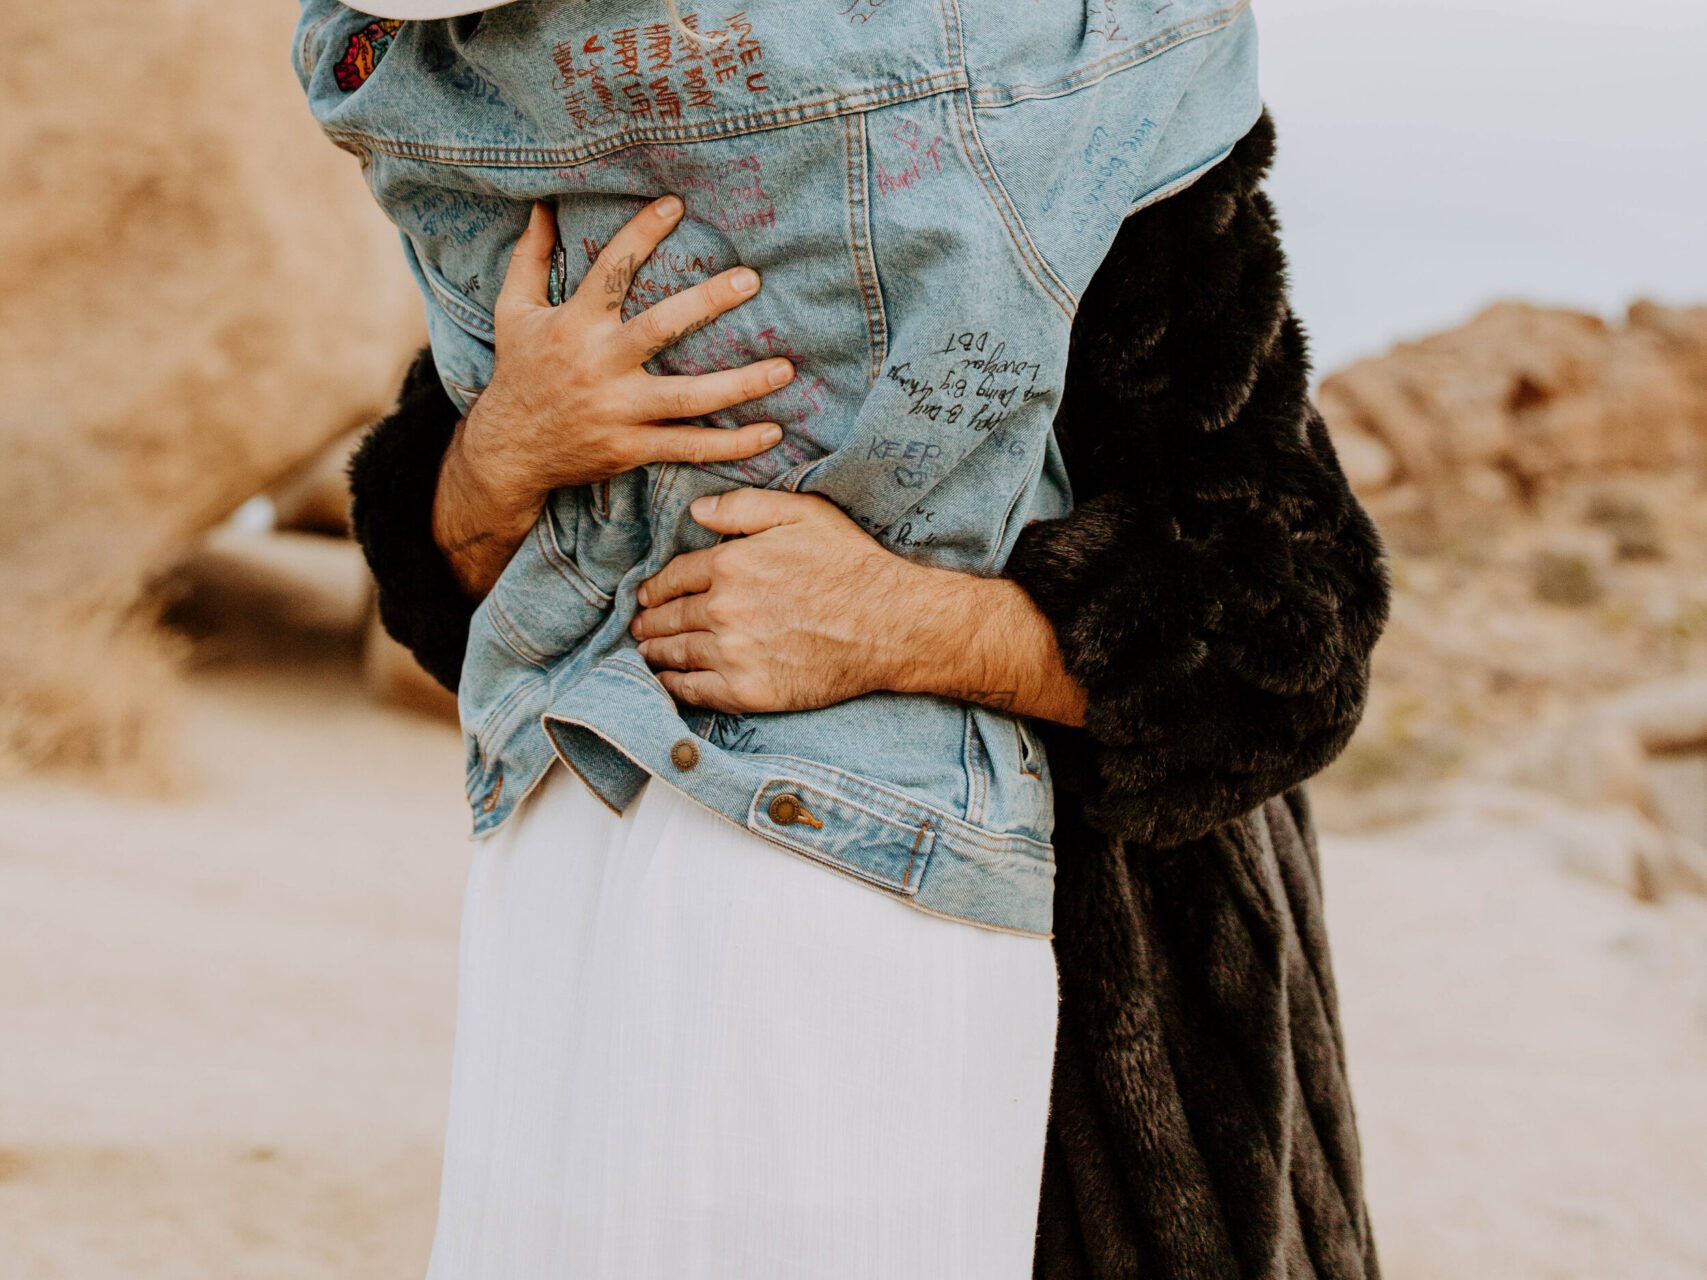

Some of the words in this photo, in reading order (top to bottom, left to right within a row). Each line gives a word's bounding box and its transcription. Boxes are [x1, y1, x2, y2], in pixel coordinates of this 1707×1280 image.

[611, 27, 643, 79] HAPPY
[643, 23, 674, 71] HAPPY
[705, 30, 738, 83] KYLE
[622, 82, 654, 123] LIFE
[649, 75, 681, 125] WIFE
[746, 72, 768, 92] U
[932, 331, 988, 354] DBT
[867, 436, 941, 468] KEEP
